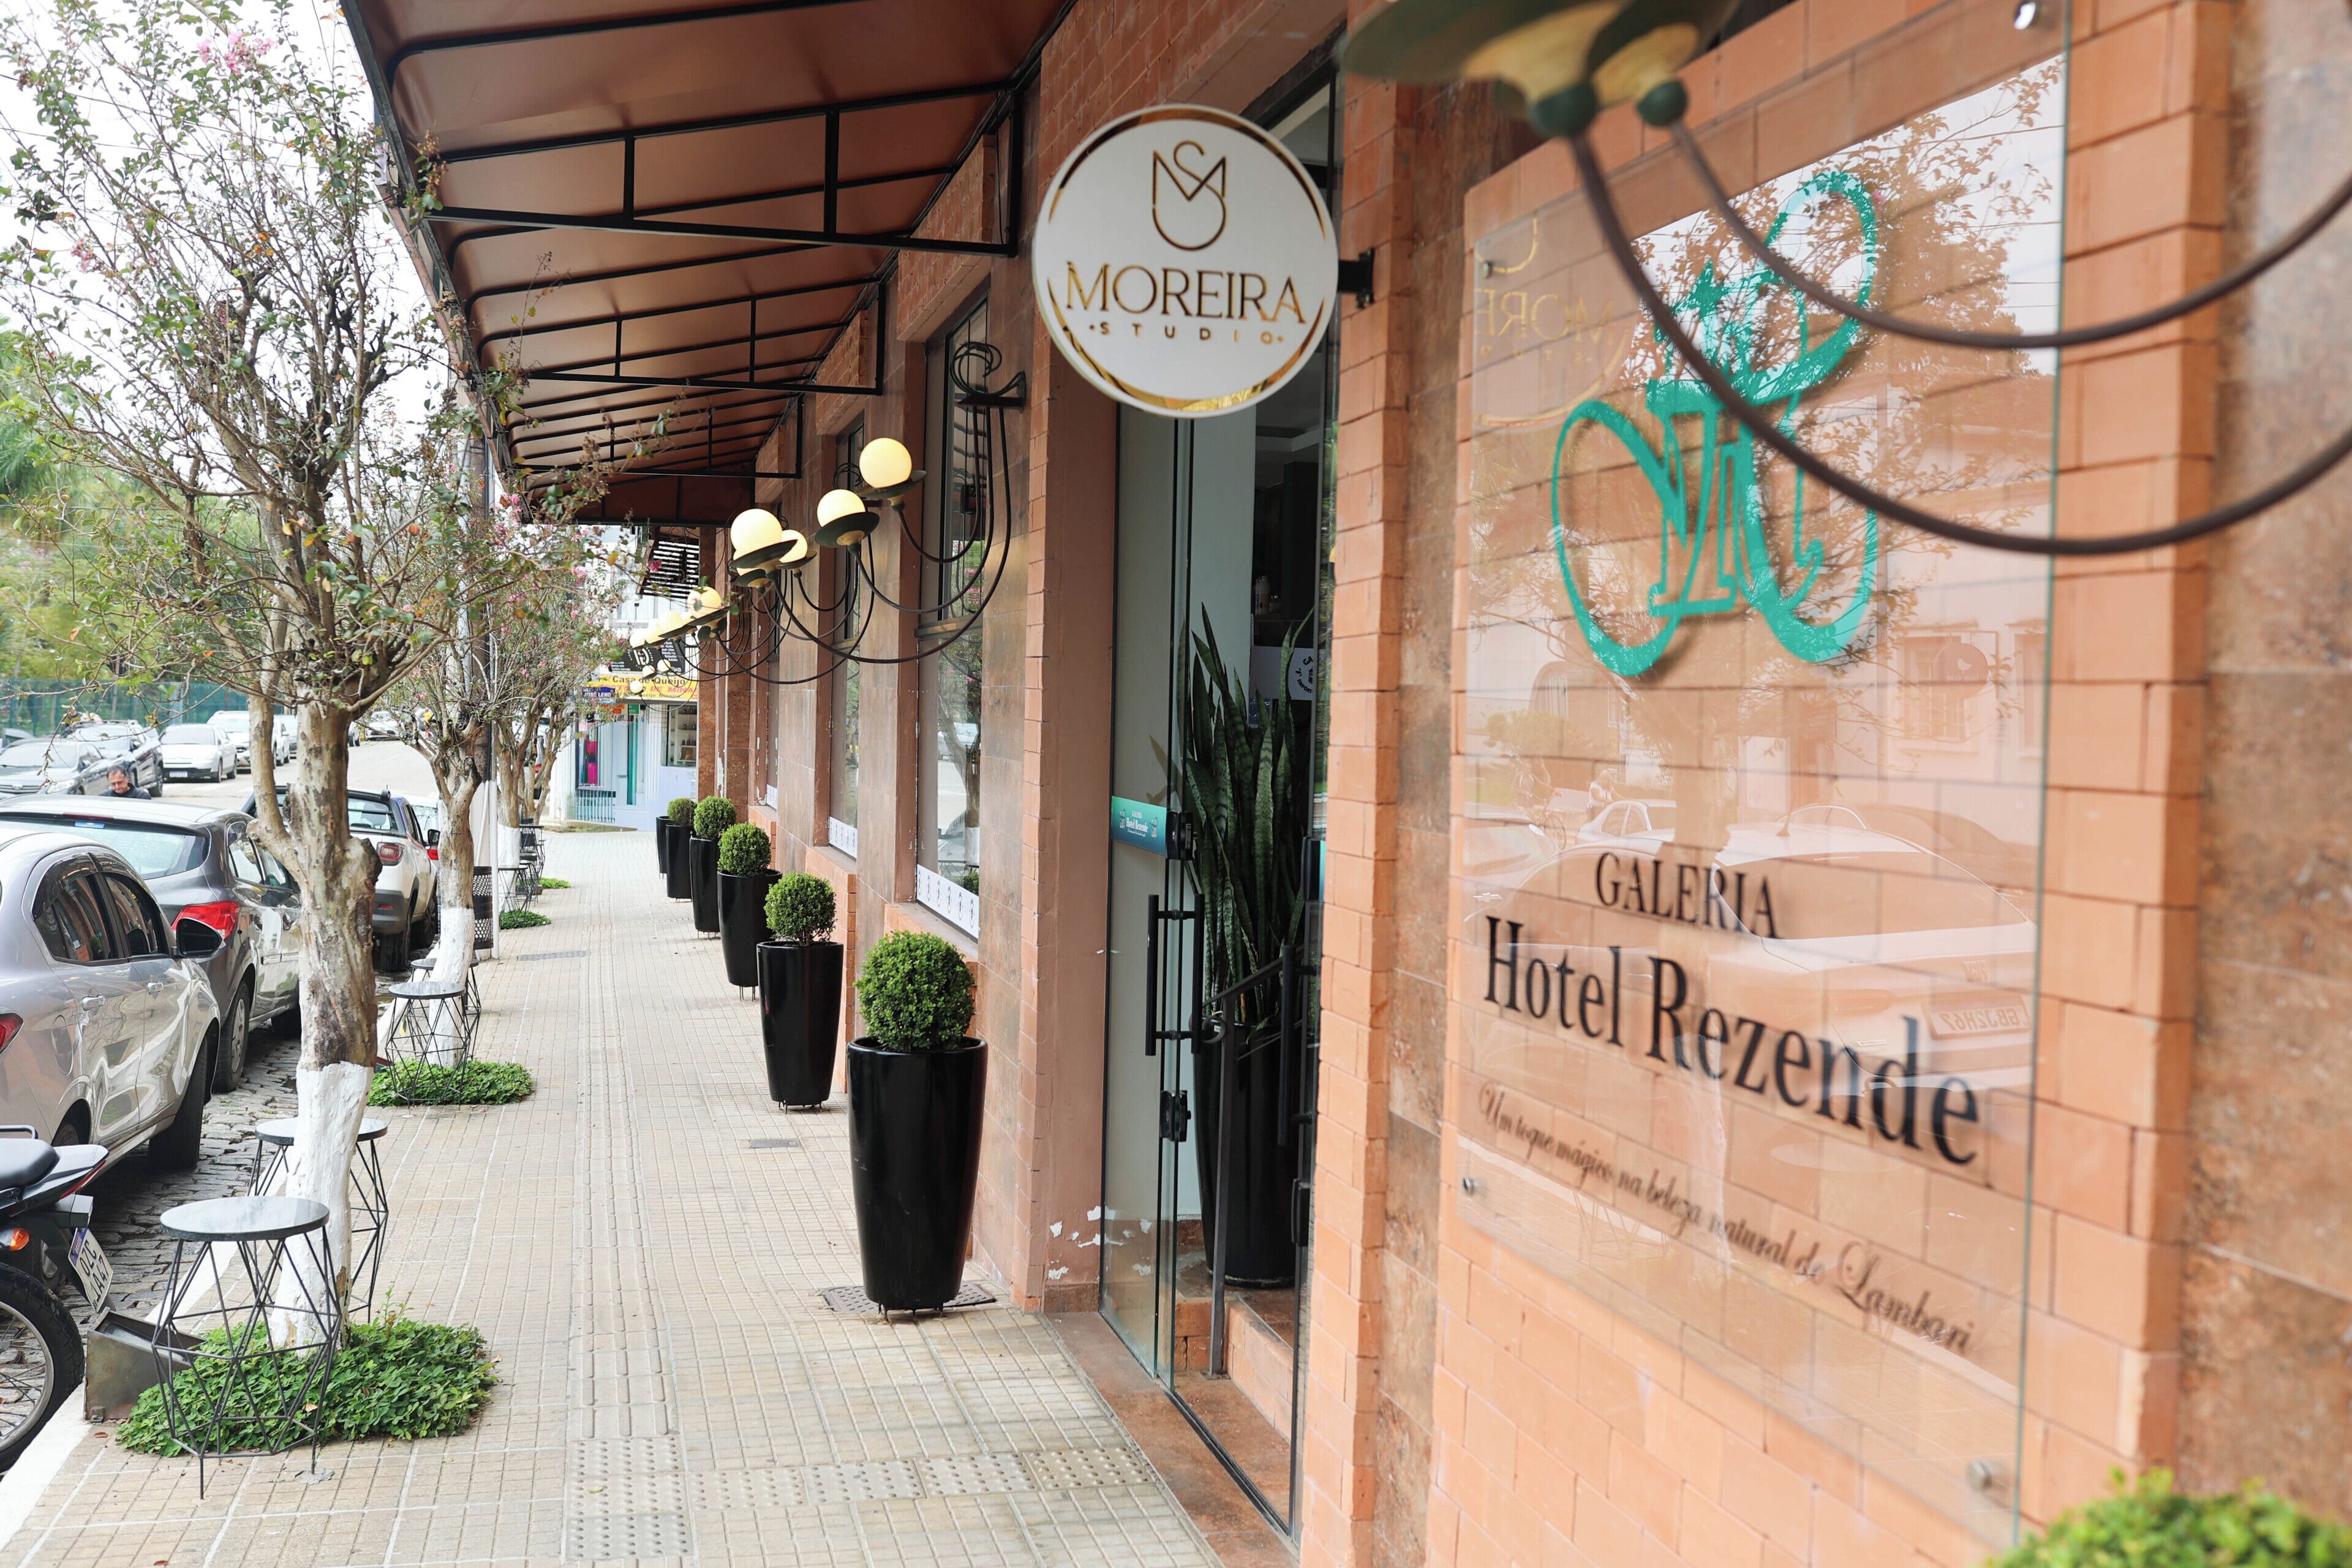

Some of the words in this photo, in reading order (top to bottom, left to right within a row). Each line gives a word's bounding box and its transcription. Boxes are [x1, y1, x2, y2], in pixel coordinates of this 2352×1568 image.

[1066, 261, 1306, 324] MOREIRA
[654, 677, 686, 687] Queijo
[1596, 851, 1783, 940] GALERIA
[1484, 915, 1623, 1048] Hotel
[1647, 954, 1980, 1166] Rezende
[1618, 1170, 1643, 1199] na
[79, 1238, 97, 1278] OZC
[90, 1255, 110, 1302] 1A47
